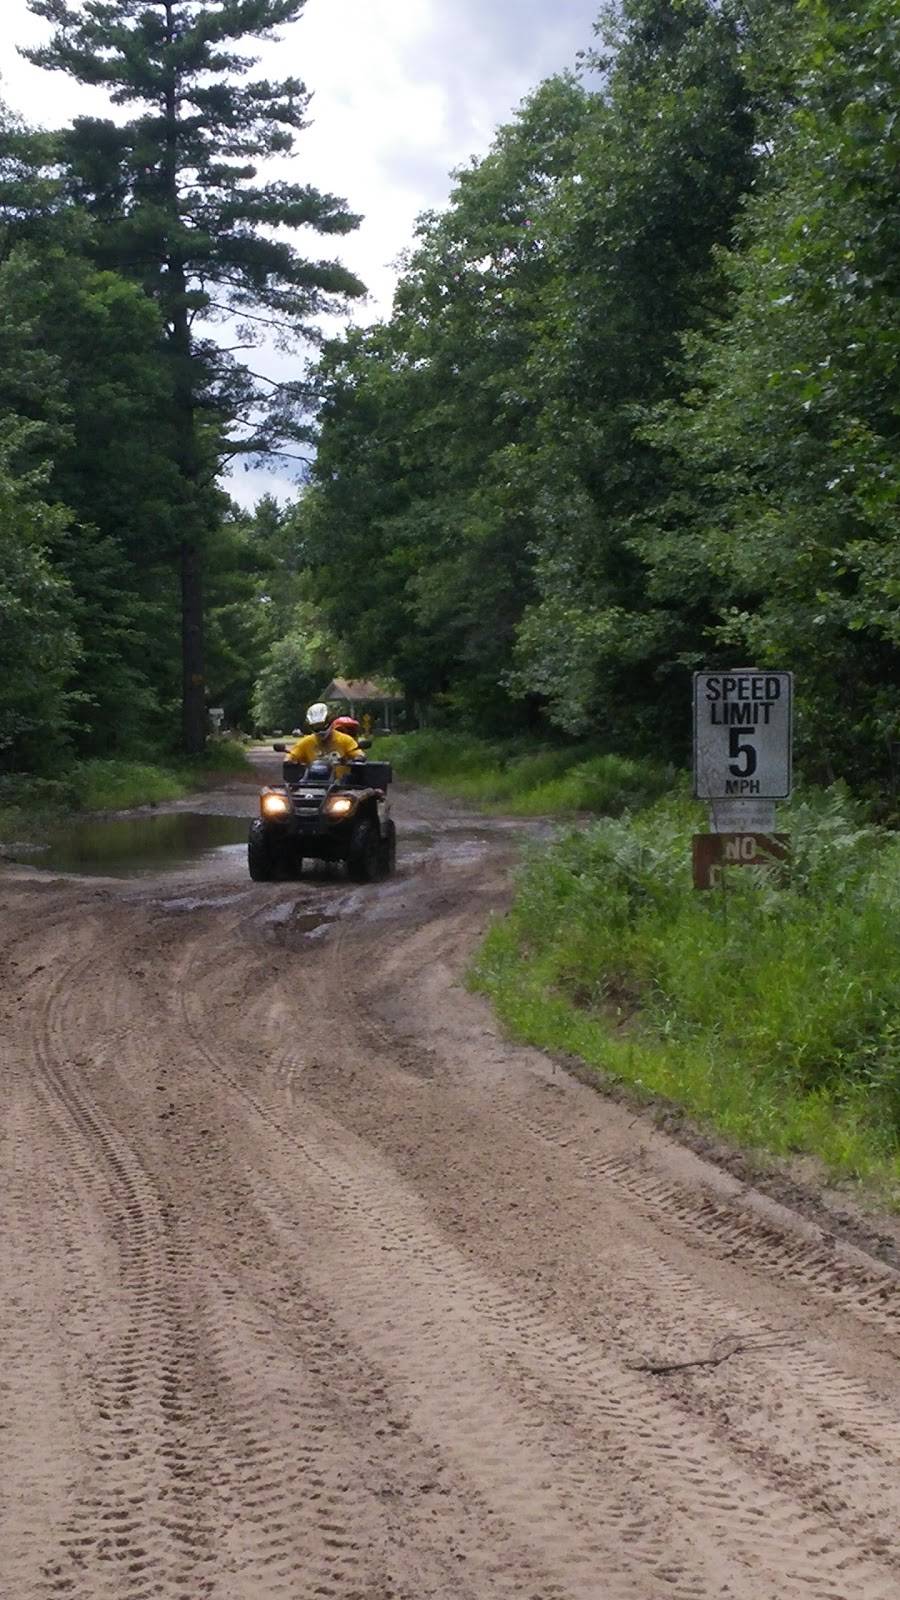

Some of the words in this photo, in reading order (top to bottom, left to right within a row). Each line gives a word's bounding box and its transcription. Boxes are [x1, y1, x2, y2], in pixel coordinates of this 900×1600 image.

[705, 677, 780, 700] SPEED
[711, 702, 774, 725] LIMIT
[729, 727, 757, 778] 5
[725, 780, 760, 794] MPH
[725, 836, 757, 860] NO
